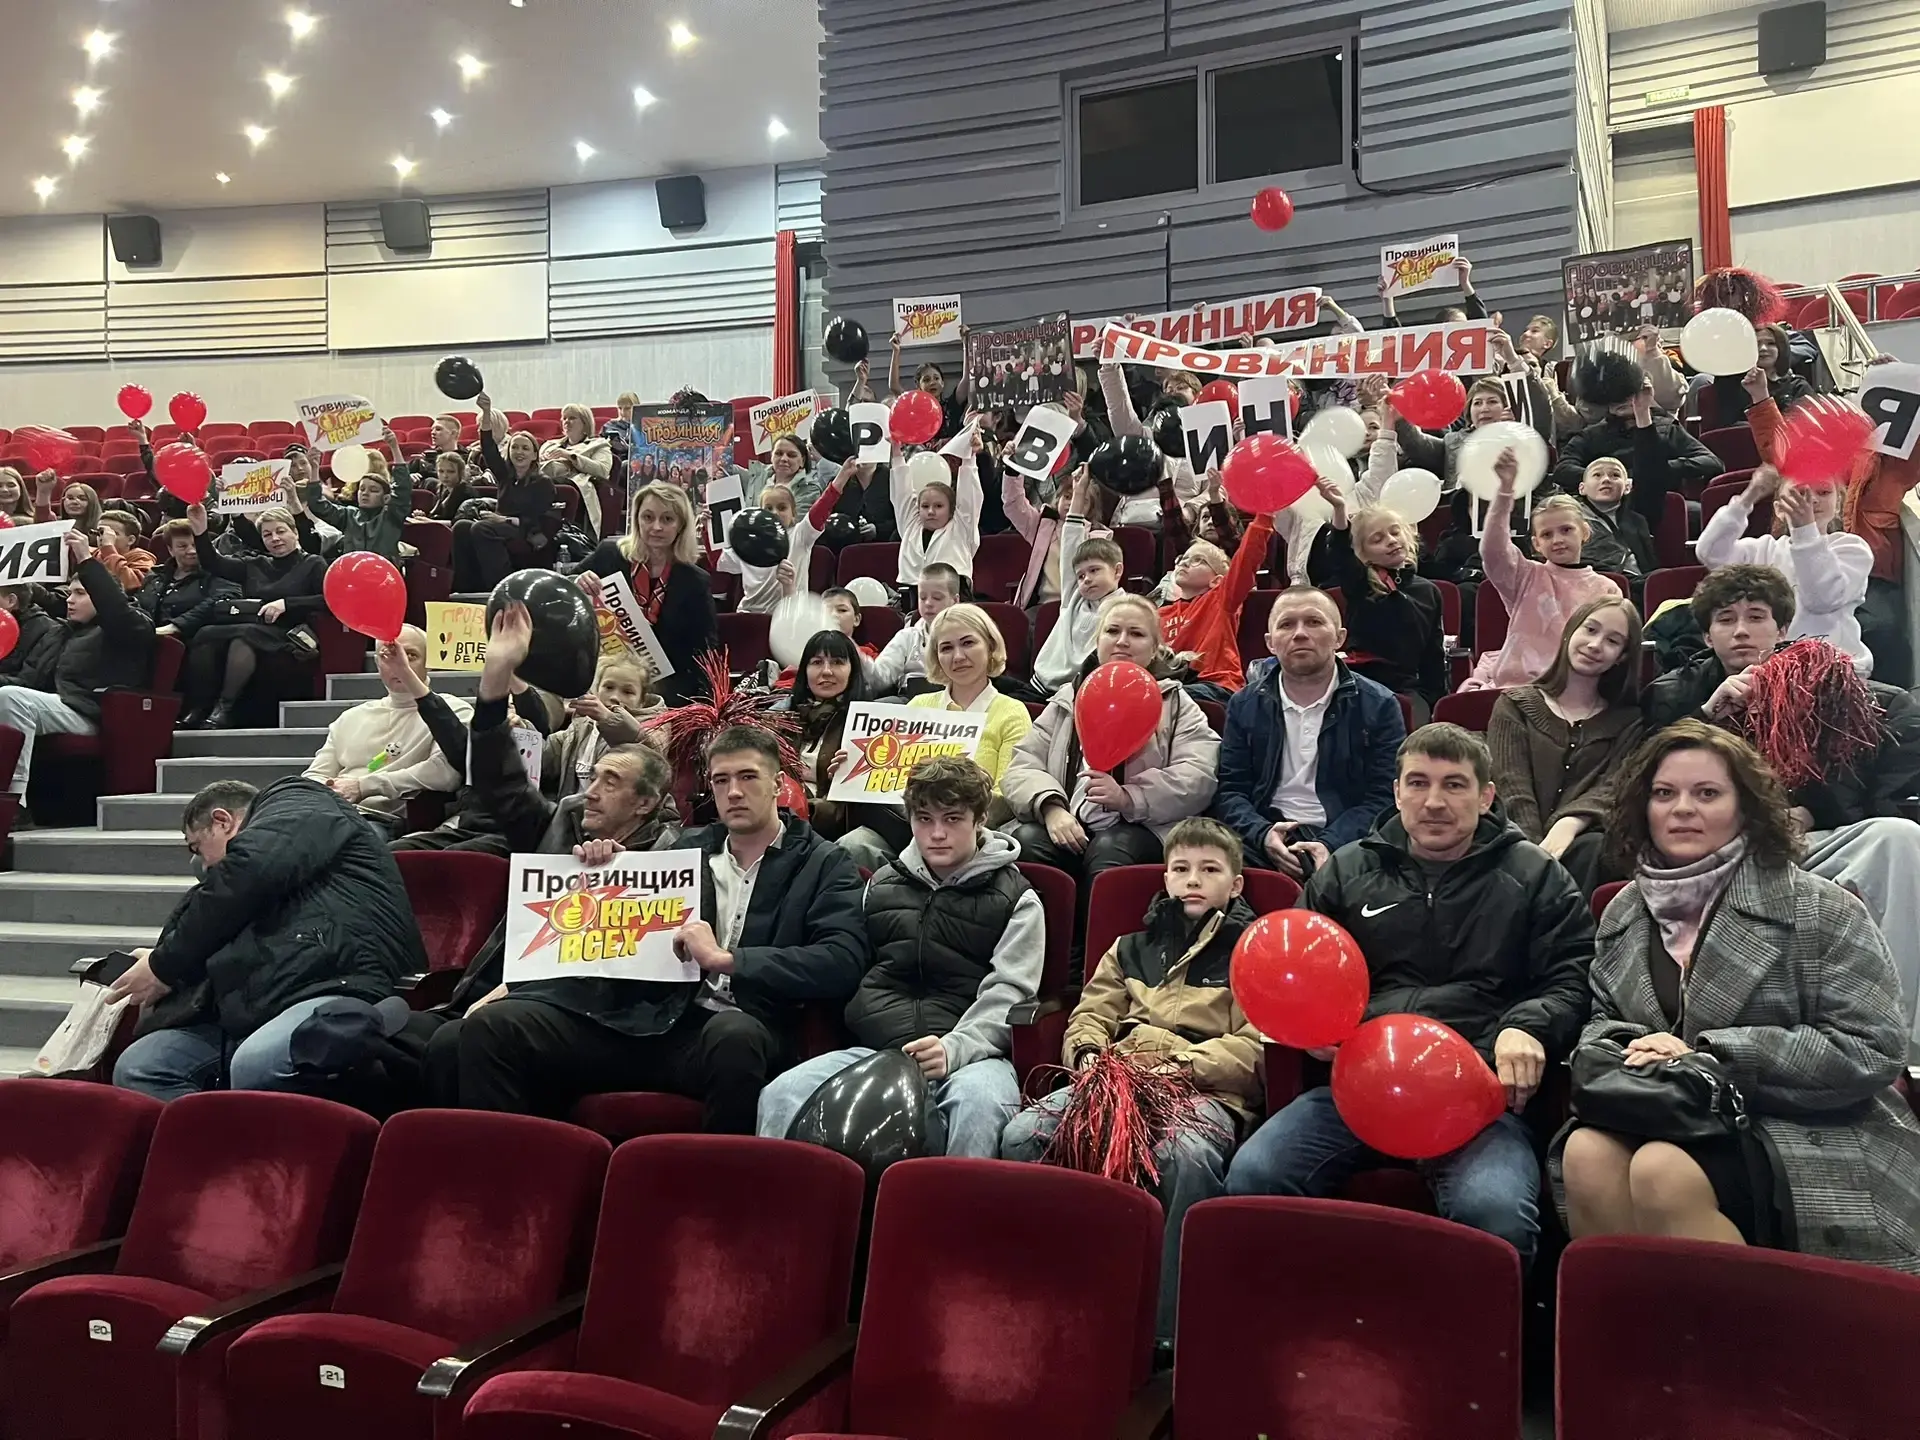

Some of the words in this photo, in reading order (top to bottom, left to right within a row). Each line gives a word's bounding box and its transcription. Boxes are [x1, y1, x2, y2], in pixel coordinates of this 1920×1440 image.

[1385, 241, 1456, 261] Провинция
[897, 301, 959, 315] Провинция
[1073, 292, 1317, 355] РВИНЦИЯ
[1102, 327, 1487, 376] ПРОВИНЦИЯ
[753, 396, 812, 420] Провинция
[1242, 400, 1288, 440] Н
[645, 423, 720, 443] ПРОВИНЦИЯ
[852, 422, 883, 458] Р
[1008, 425, 1058, 471] В
[1187, 424, 1229, 475] И
[221, 491, 283, 506] Провинция
[456, 641, 487, 655] ВПЕ
[851, 712, 979, 740] Провинция
[522, 868, 694, 898] Провинция
[599, 896, 686, 928] КРУЧЕ
[558, 928, 638, 964] ВСЕХ
[93, 1325, 108, 1335] 20
[326, 1370, 340, 1382] 21
